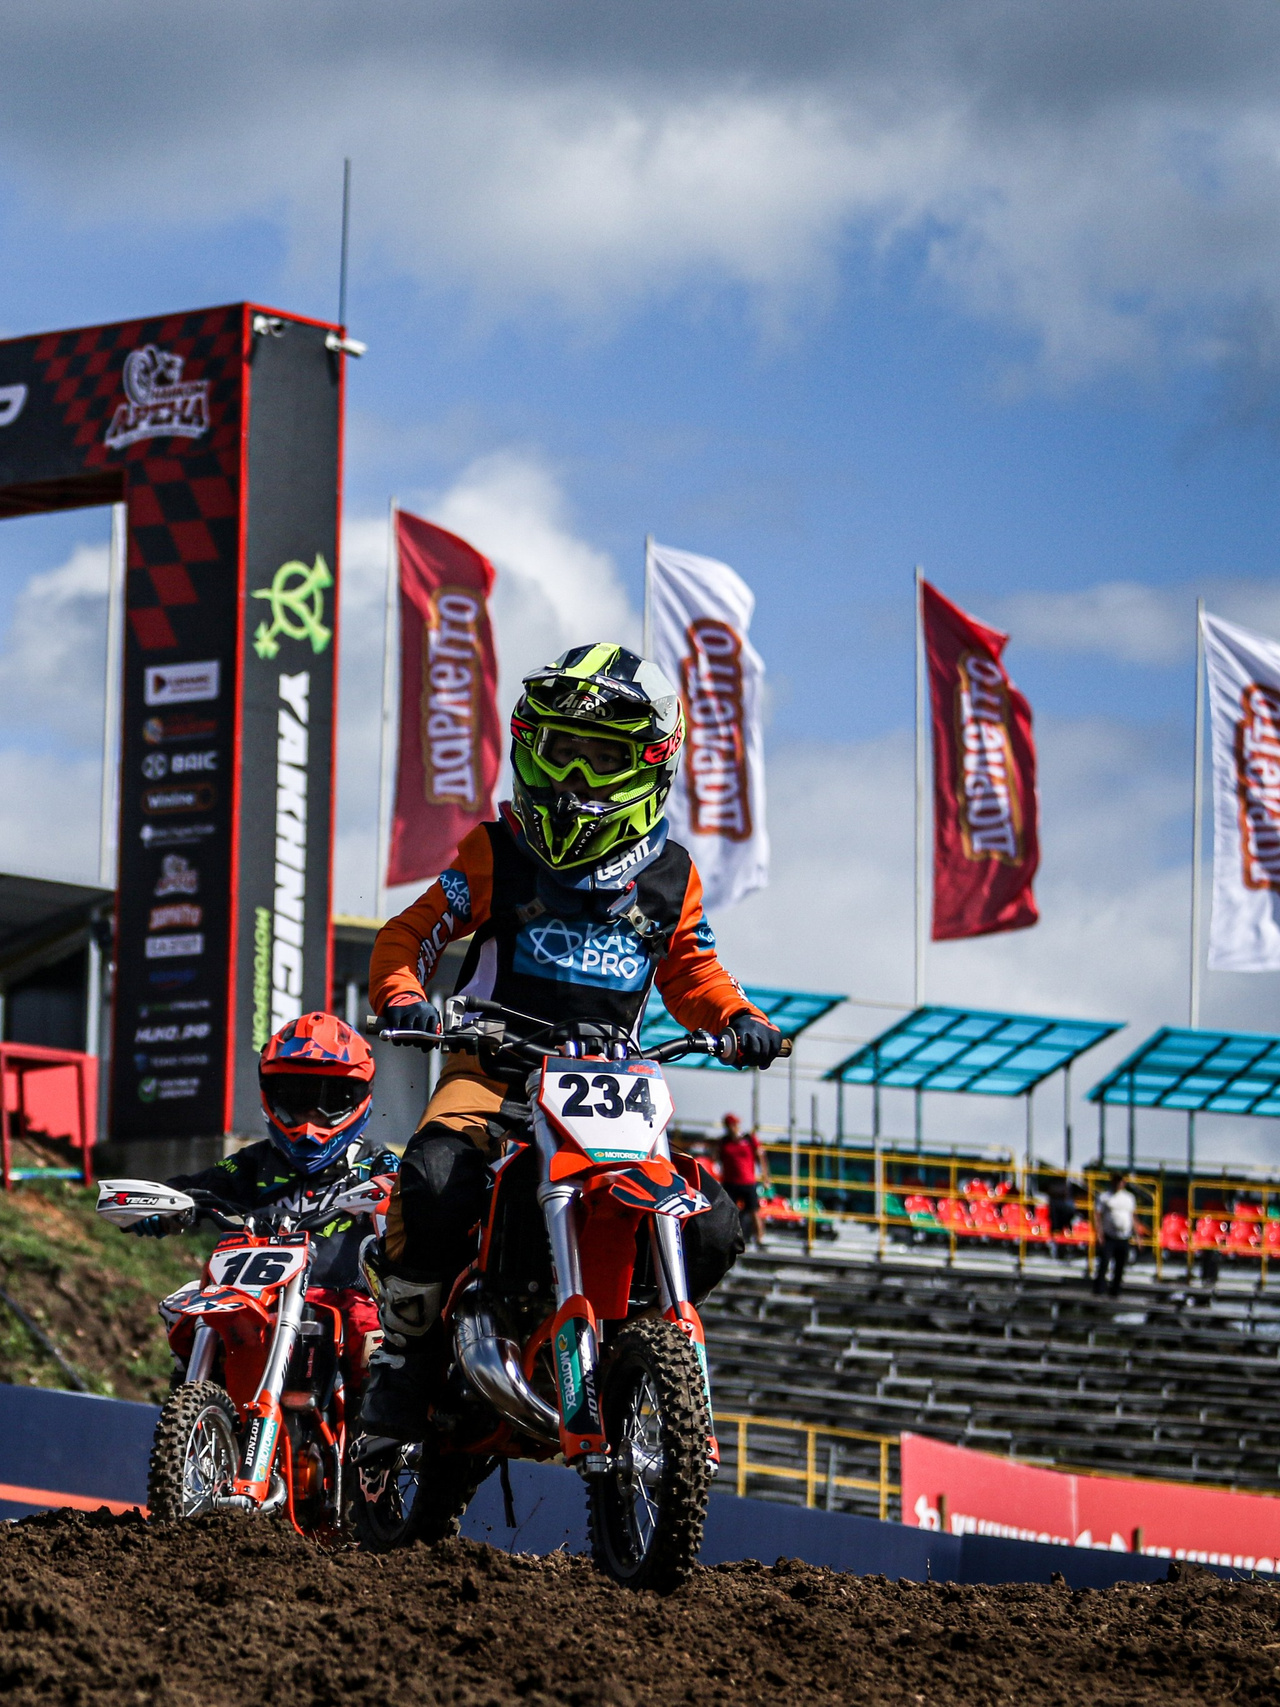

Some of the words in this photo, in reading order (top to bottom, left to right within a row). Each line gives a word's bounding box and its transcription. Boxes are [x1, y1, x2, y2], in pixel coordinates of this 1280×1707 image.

[558, 692, 606, 716] Airoh
[171, 750, 218, 773] BAIC
[596, 835, 651, 882] LEATT
[450, 877, 470, 900] KA
[584, 922, 640, 955] KAS
[252, 906, 271, 1053] MOTORSPORT
[581, 949, 640, 980] PRO
[558, 1073, 657, 1121] 234
[604, 1150, 641, 1161] MOTOREX
[220, 1251, 294, 1286] 16
[559, 1350, 578, 1411] MOTOREX
[245, 1419, 260, 1467] DUNLOP
